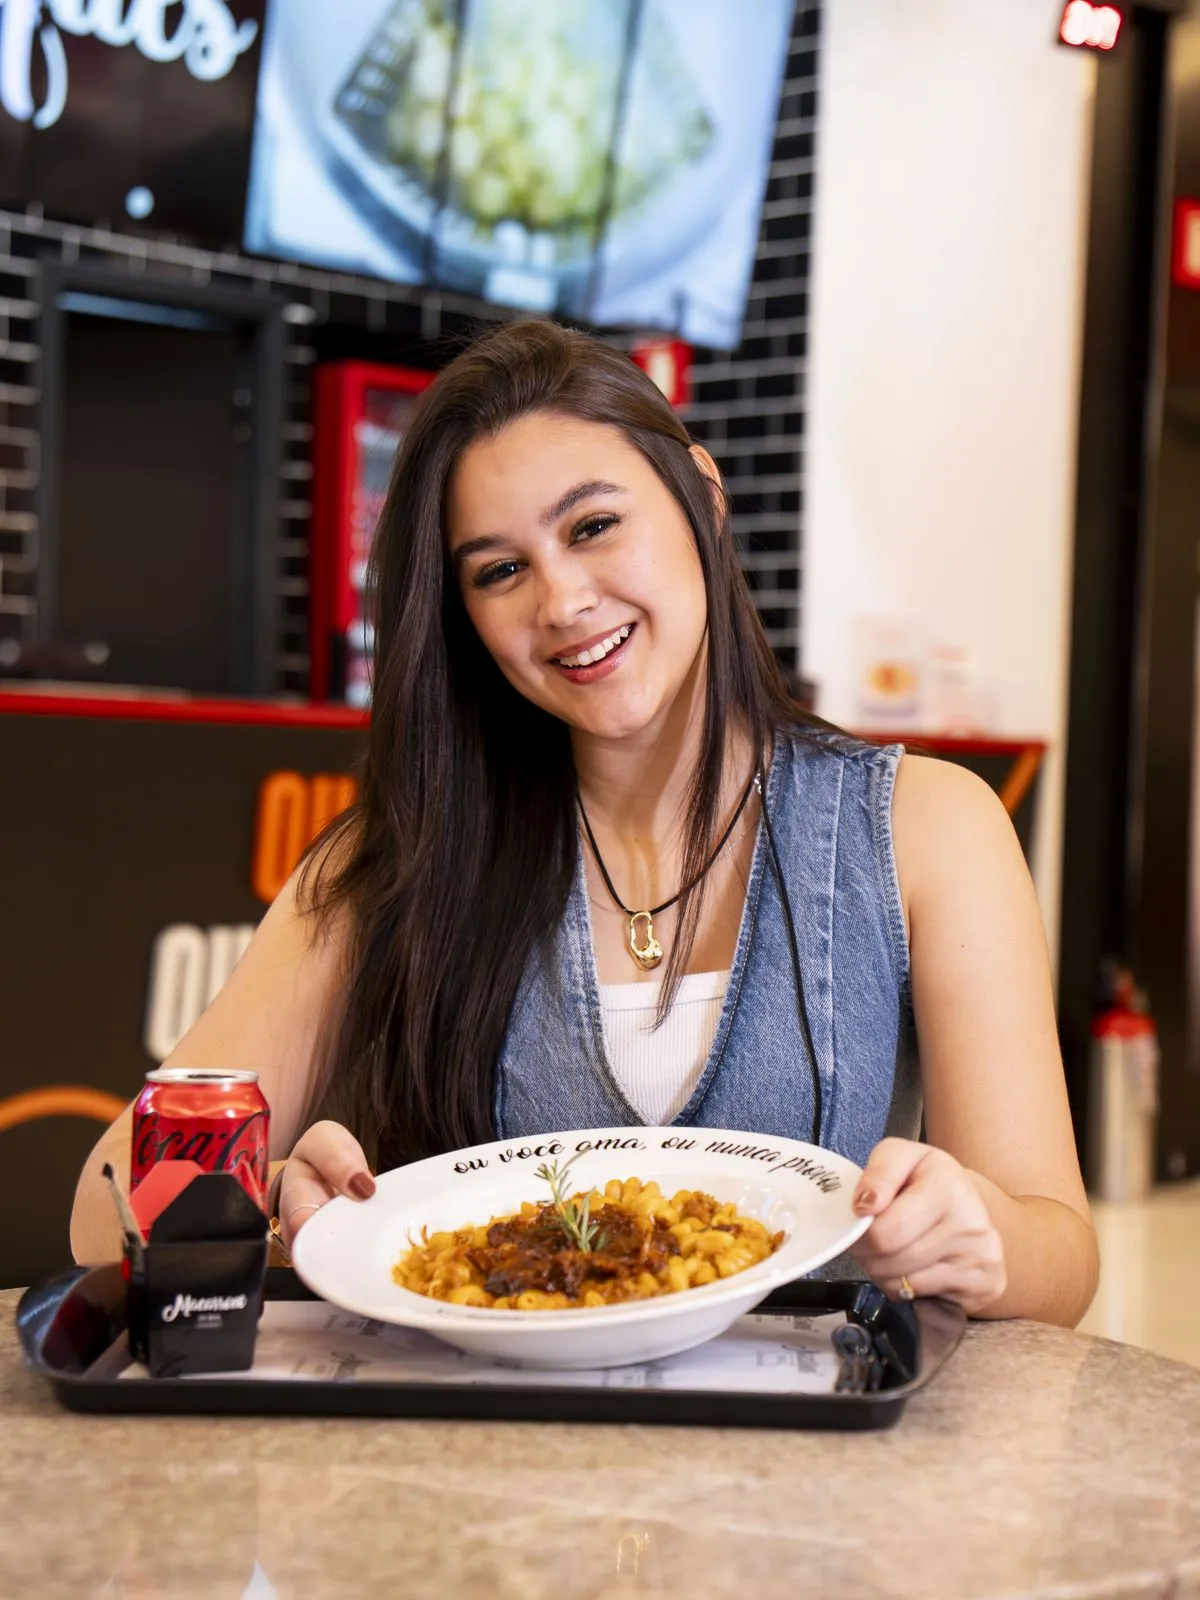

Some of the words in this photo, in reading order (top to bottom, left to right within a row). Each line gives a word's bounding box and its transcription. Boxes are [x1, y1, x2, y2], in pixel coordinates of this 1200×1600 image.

[453, 1158, 489, 1174] ou
[499, 1138, 565, 1163] você
[575, 1138, 647, 1152] ama,
[661, 1136, 698, 1150] ou
[704, 1141, 781, 1162] nunca
